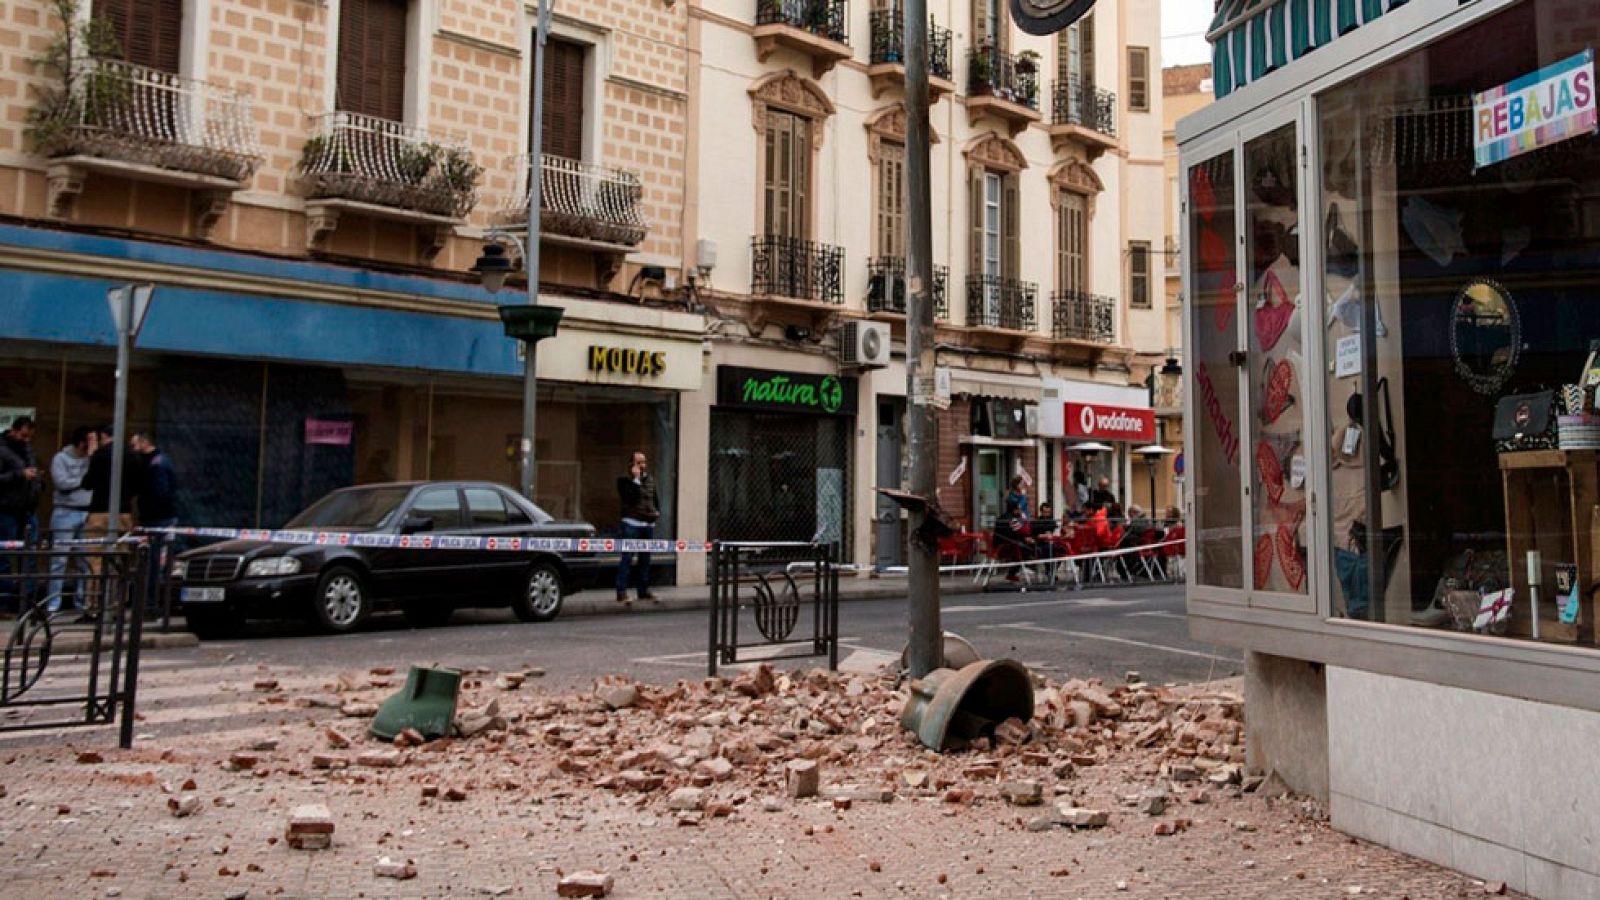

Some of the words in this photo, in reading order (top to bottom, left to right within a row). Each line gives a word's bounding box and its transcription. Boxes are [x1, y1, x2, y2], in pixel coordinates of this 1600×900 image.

[1478, 72, 1591, 143] REBAJAS
[589, 346, 666, 376] MODAS
[743, 376, 818, 405] natura
[1097, 411, 1143, 432] vodafone
